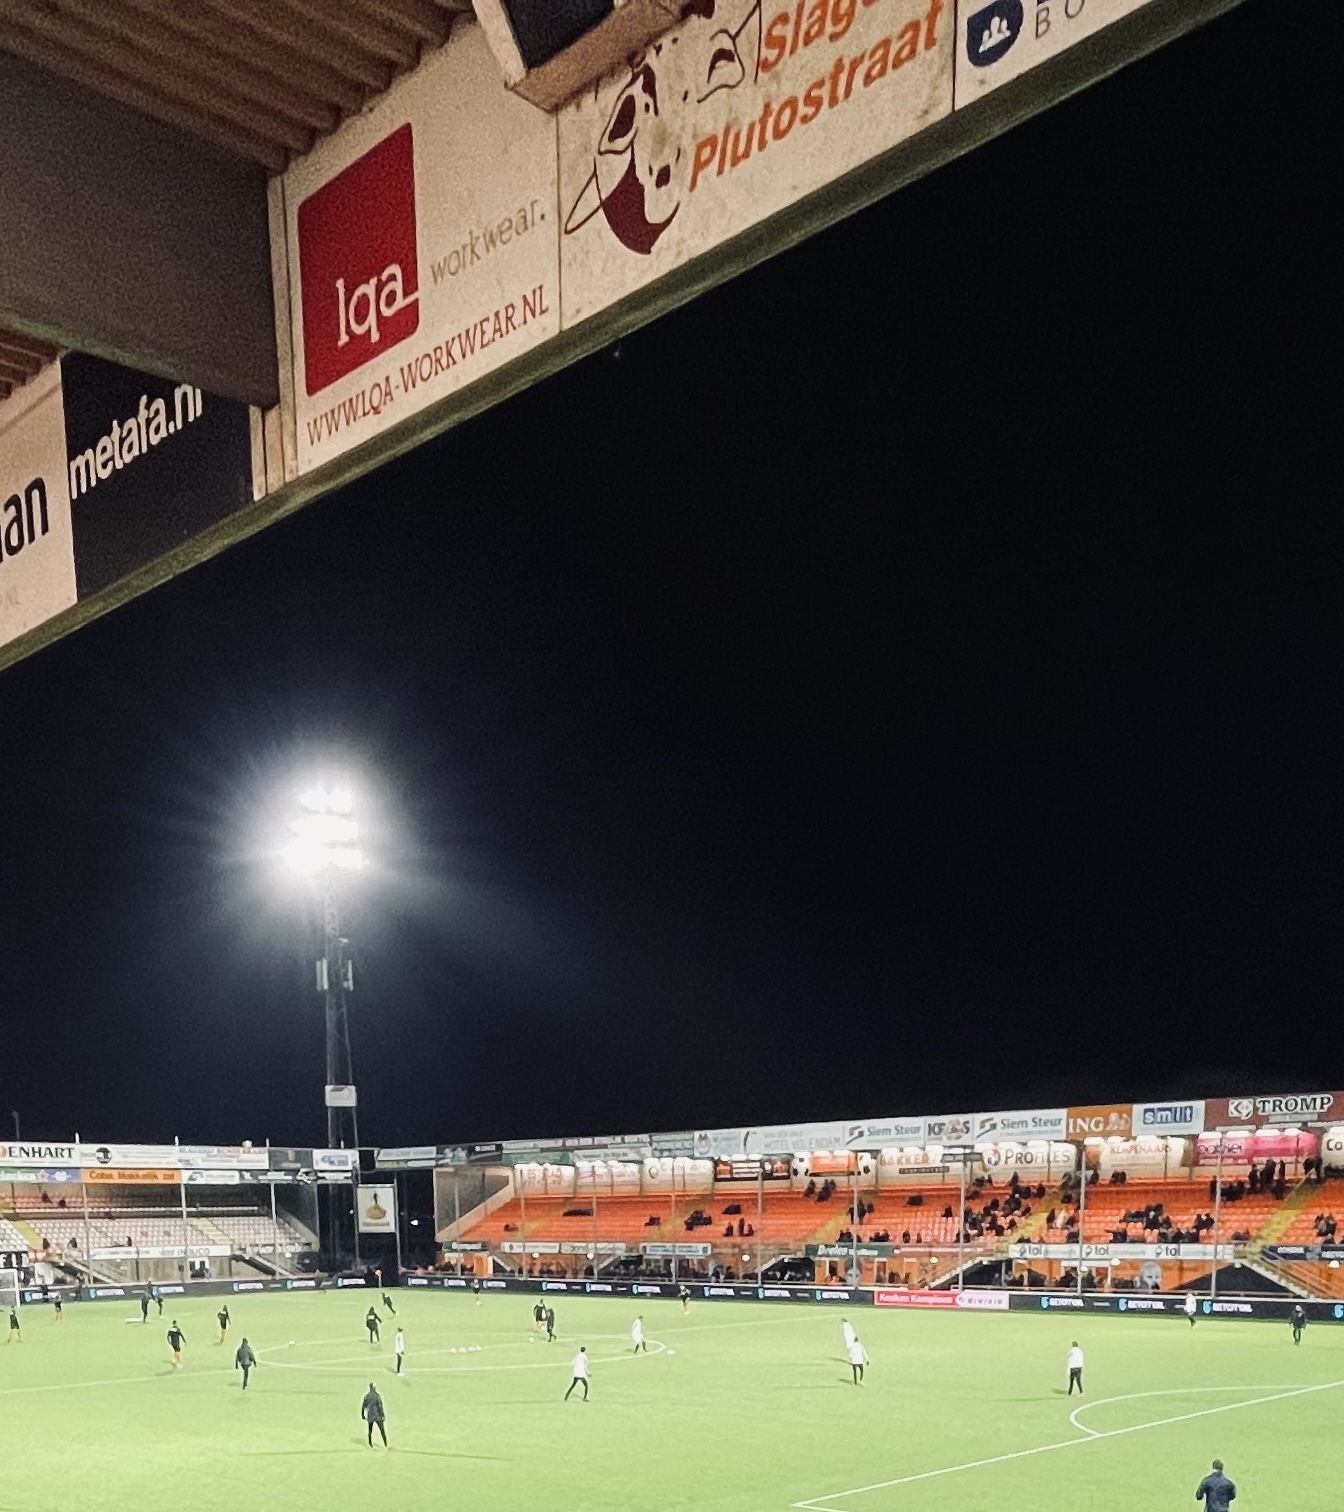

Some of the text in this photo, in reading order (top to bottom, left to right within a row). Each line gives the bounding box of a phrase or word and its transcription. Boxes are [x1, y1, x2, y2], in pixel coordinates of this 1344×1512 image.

[760, 0, 878, 74] Slag
[689, 0, 945, 192] Plutostraat
[335, 262, 420, 348] lqa
[307, 284, 550, 448] WWW.LQA-WORKWEAR.NL
[69, 382, 204, 500] metafa.nl
[1067, 1117, 1104, 1134] ING
[1257, 1095, 1333, 1113] TROMP
